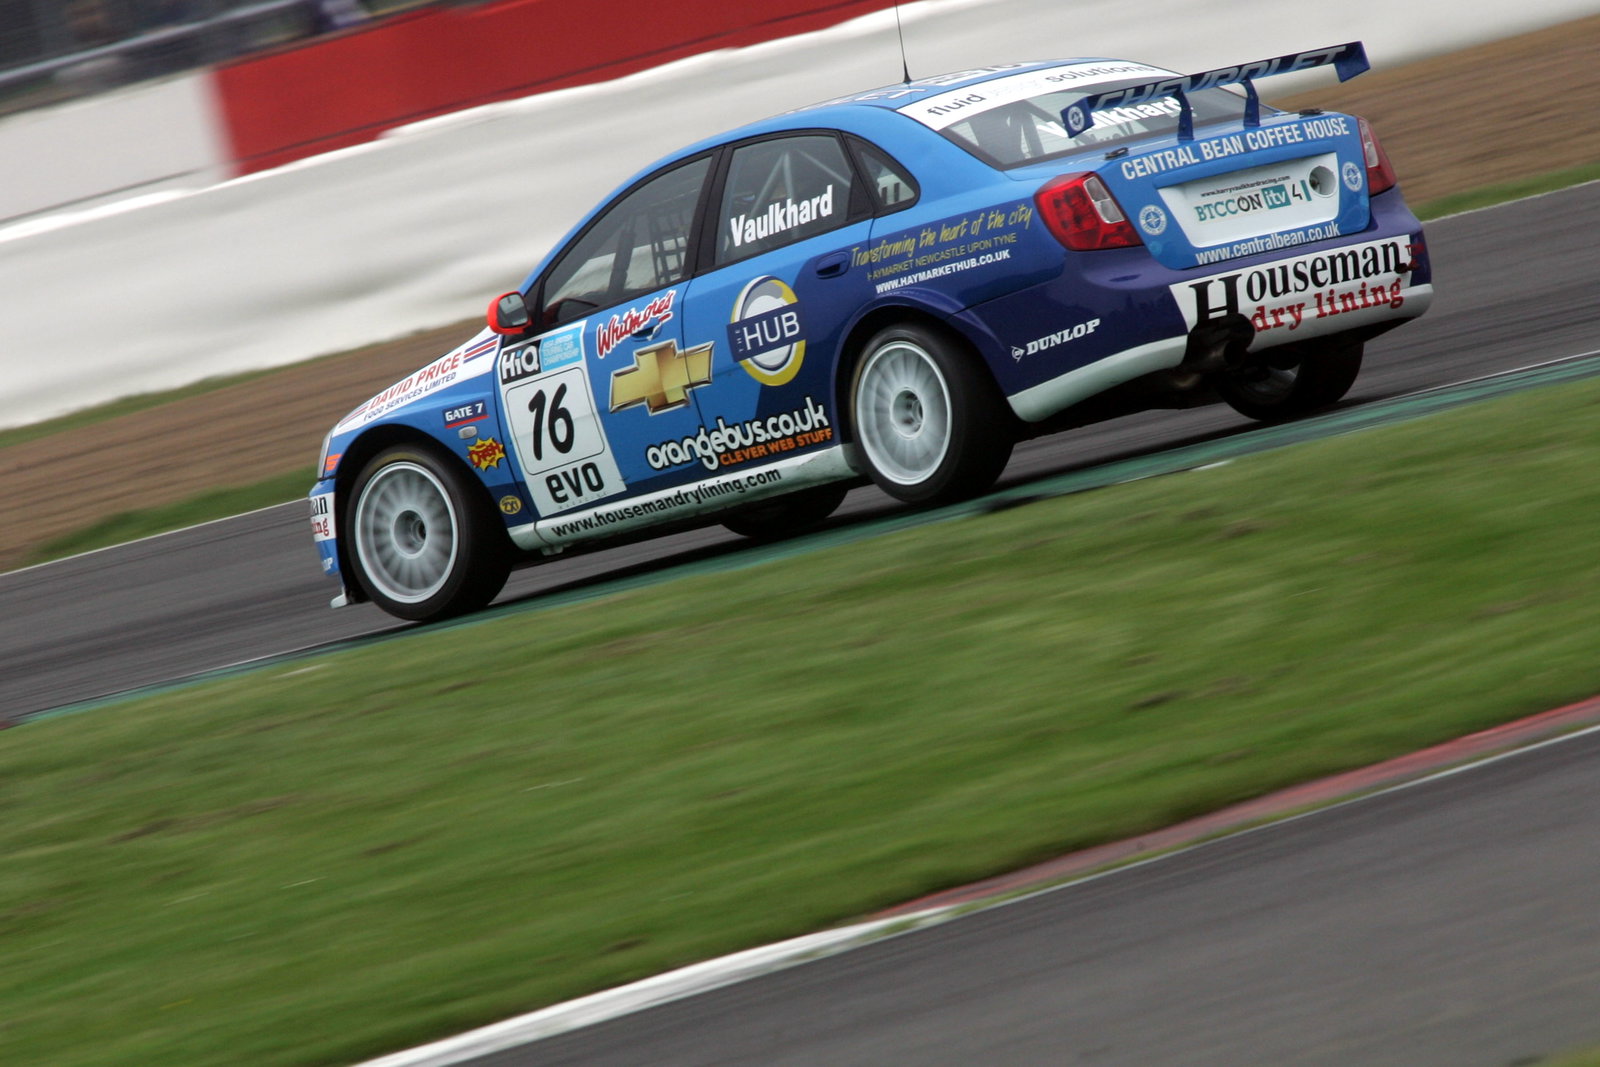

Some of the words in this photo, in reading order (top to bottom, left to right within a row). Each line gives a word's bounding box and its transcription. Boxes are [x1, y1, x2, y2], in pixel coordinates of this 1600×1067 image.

[927, 94, 987, 116] fluid
[1045, 65, 1154, 84] solutions
[1121, 145, 1200, 181] CENTRAL
[1201, 135, 1245, 162] BEAN
[1246, 121, 1304, 151] COFFEE
[1305, 117, 1350, 140] HOUSE
[731, 184, 833, 247] Vaulkhard
[850, 233, 917, 267] Transforming
[918, 228, 937, 250] the
[939, 218, 968, 242] heart
[970, 212, 986, 237] of
[986, 210, 1006, 231] the
[1008, 203, 1033, 230] city
[915, 245, 966, 267] NEWCASTLE
[967, 239, 992, 254] UPON
[993, 232, 1017, 246] TYNE
[1195, 221, 1342, 265] www.centralbean.co.uk
[875, 249, 1011, 294] WWW.HAYMARKETHUB.CO.UK
[1250, 300, 1306, 332] dry
[1314, 277, 1405, 319] lining
[743, 311, 800, 351] HUB
[1026, 318, 1100, 356] DUNLOP
[368, 377, 414, 410] DAVID
[415, 352, 462, 387] PRICE
[501, 345, 540, 380] HiQ
[364, 405, 385, 421] FOOD
[385, 386, 423, 410] SERVICES
[424, 372, 457, 392] LIMITED
[445, 405, 473, 421] GATE
[475, 402, 484, 414] 7
[528, 382, 575, 461] 16
[647, 397, 829, 471] orangebus.co.uk
[720, 443, 767, 466] CLEVER
[767, 439, 796, 457] WEB
[796, 428, 833, 447] STUFF
[545, 462, 605, 504] evo
[551, 468, 782, 538] www.housemandrylining.com
